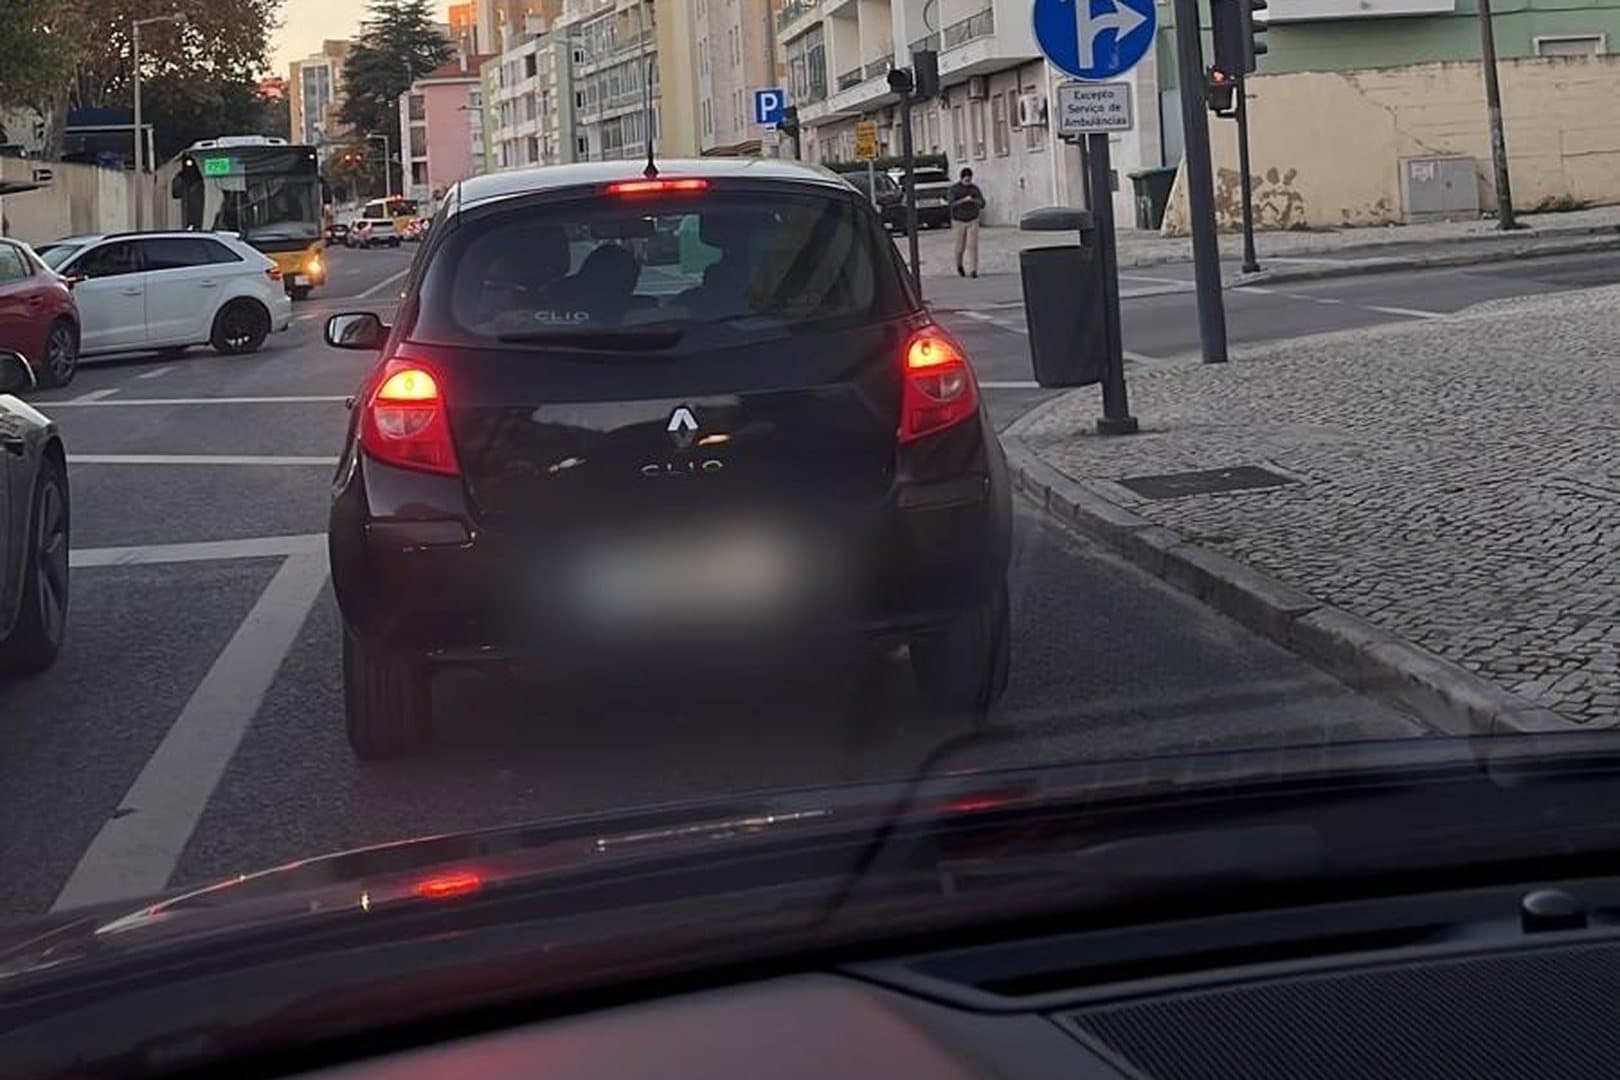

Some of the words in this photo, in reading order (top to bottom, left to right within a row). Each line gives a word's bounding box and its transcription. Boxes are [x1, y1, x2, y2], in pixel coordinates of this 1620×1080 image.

[1073, 90, 1115, 100] Excepto
[760, 93, 778, 121] P
[1067, 103, 1105, 114] Serviço
[1108, 103, 1121, 112] de
[1063, 116, 1127, 127] Ambulâncias
[534, 311, 589, 321] CLIO
